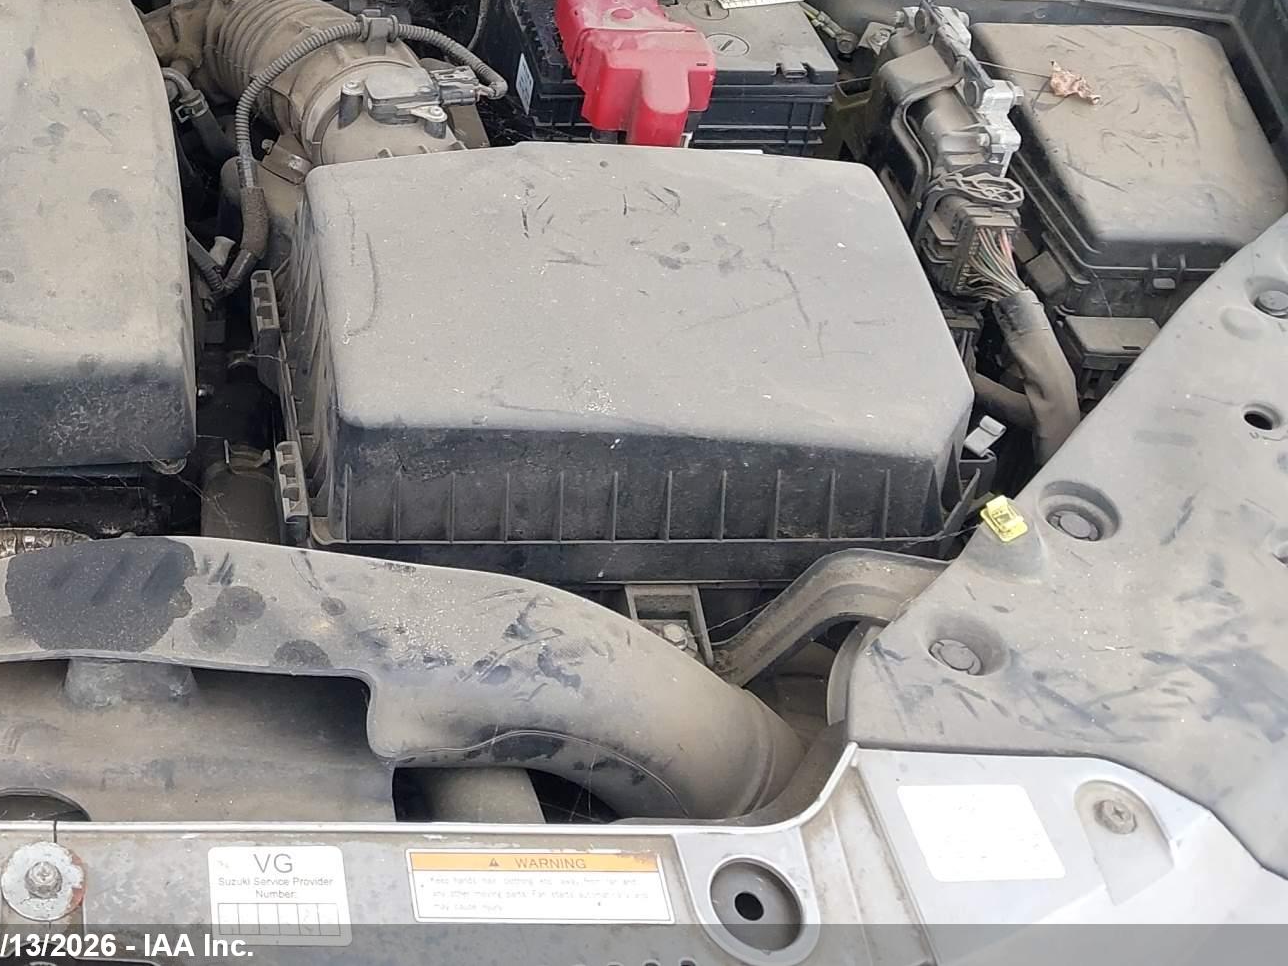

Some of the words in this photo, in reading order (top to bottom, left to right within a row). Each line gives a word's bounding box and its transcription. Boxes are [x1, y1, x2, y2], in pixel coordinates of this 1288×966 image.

[253, 853, 293, 873] VG
[516, 859, 586, 869] WARNING
[218, 877, 250, 886] Suzuki
[254, 877, 290, 886] Service
[293, 877, 334, 886] Provider
